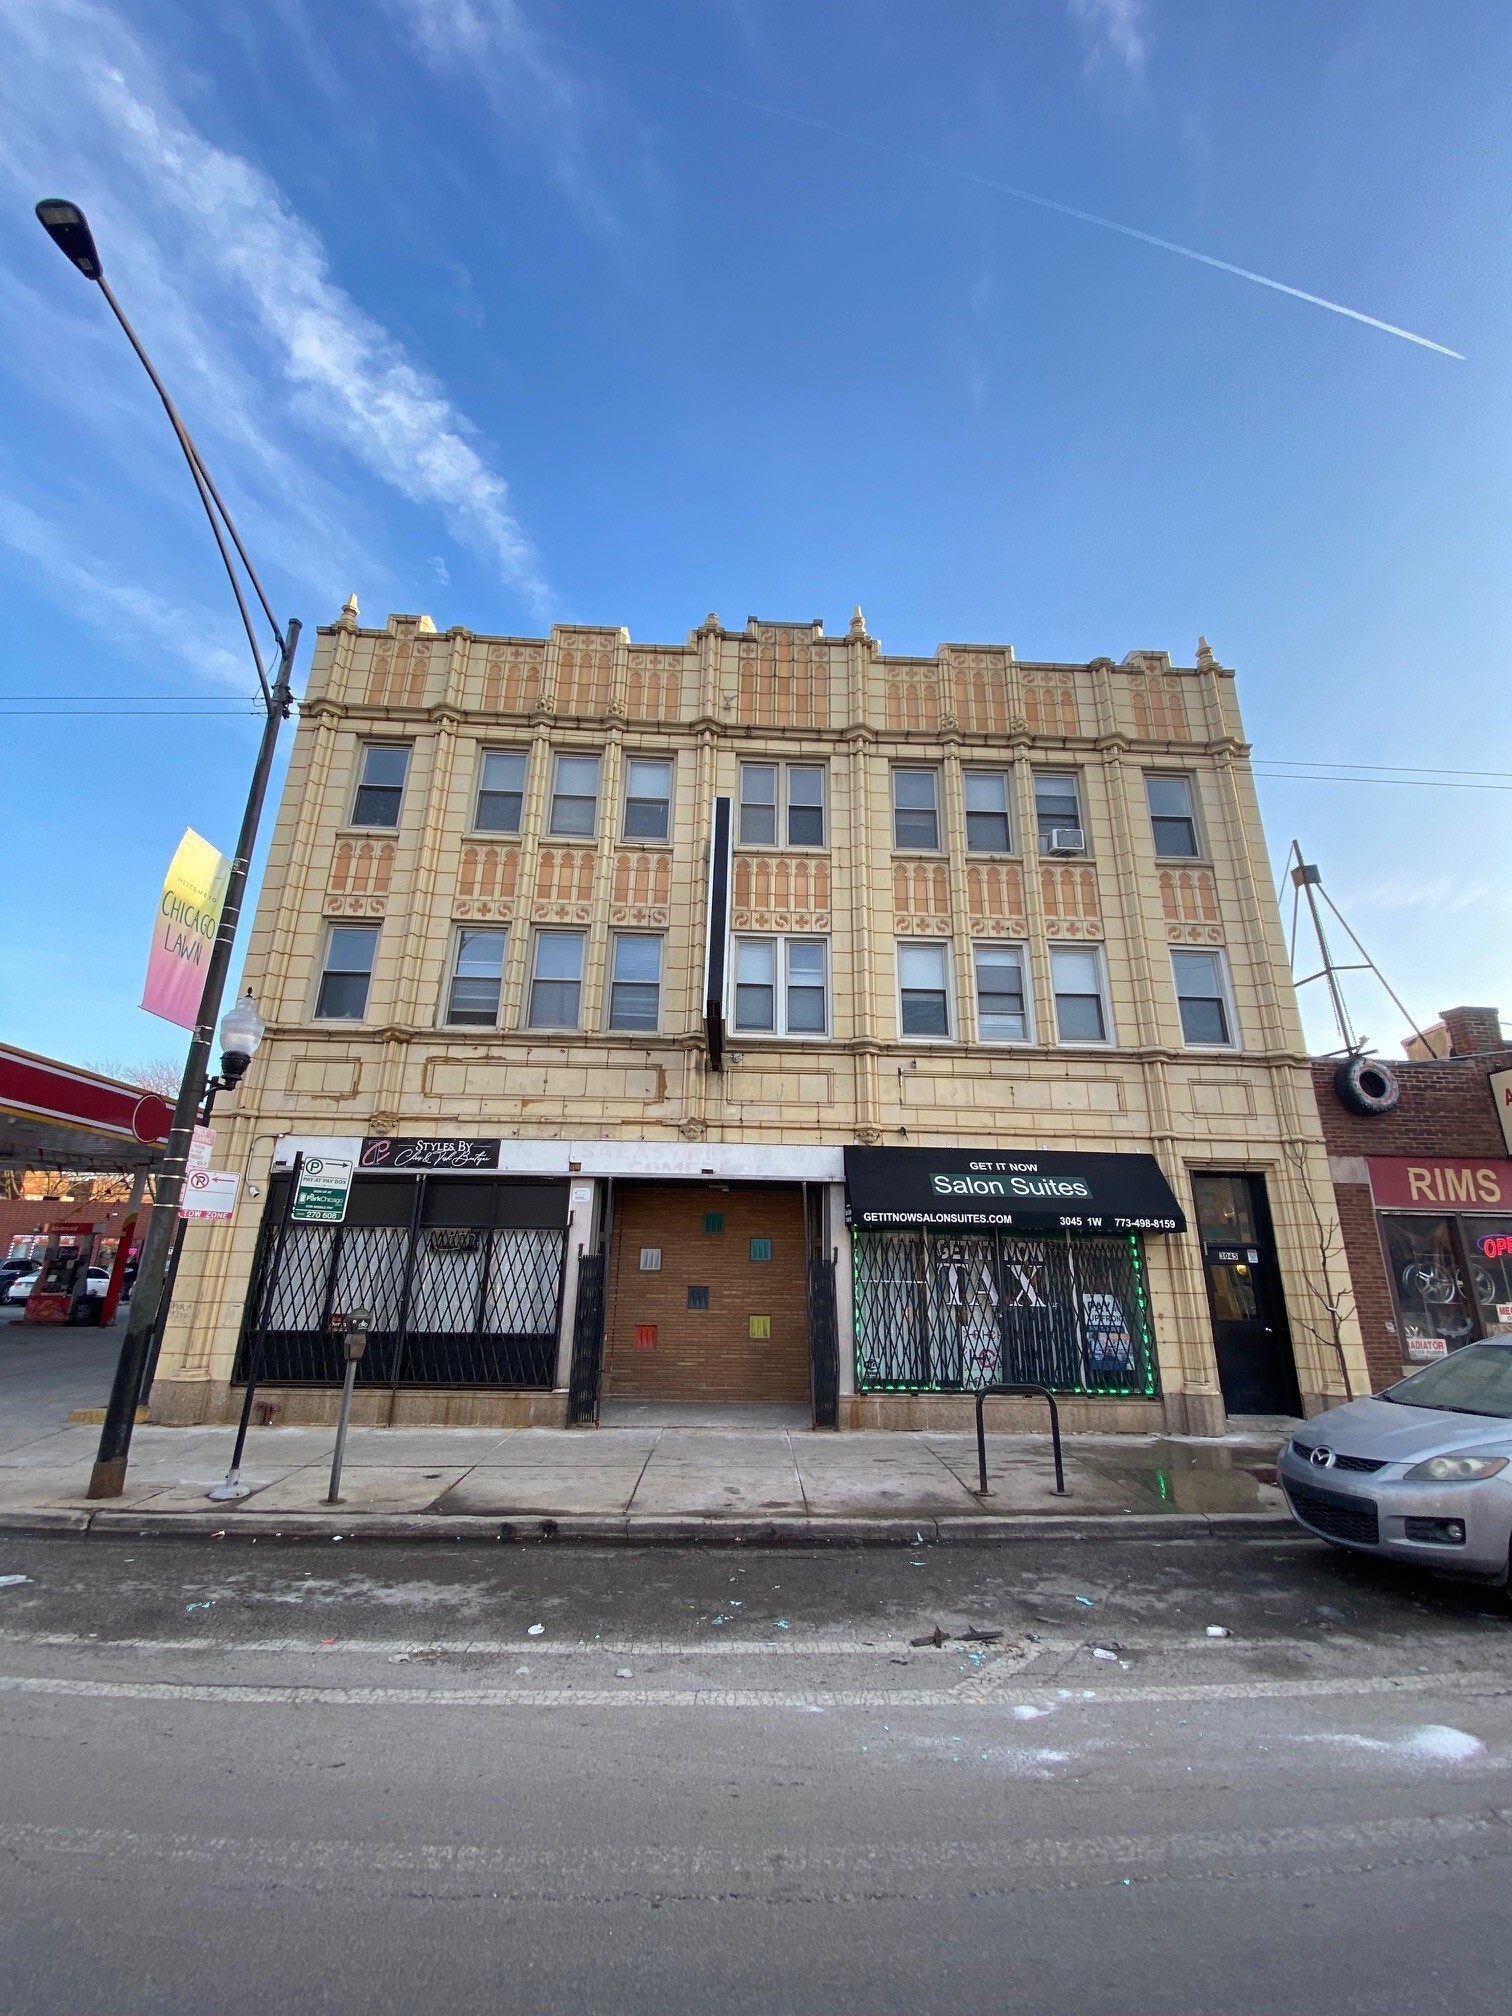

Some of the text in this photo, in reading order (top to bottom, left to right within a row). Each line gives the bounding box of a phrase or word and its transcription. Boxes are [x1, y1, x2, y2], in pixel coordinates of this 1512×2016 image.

[162, 890, 216, 939] CHICAGO
[164, 923, 203, 966] LAWN
[416, 1140, 455, 1151] STYLES
[969, 1162, 1038, 1172] GET IT NOW
[934, 1176, 1088, 1196] Salon Suites
[1407, 1167, 1501, 1203] RIMS
[306, 1194, 344, 1204] ParkChicago
[183, 1210, 228, 1219] TOW ZONE
[322, 1212, 337, 1220] 608
[863, 1212, 1012, 1224] GETITNOWSALONSUITES.COM
[1059, 1216, 1176, 1229] 3045 1W 773-498-8159
[937, 1240, 1044, 1262] GET IT NOW
[936, 1262, 1047, 1307] TAX
[1499, 1306, 1512, 1315] ME
